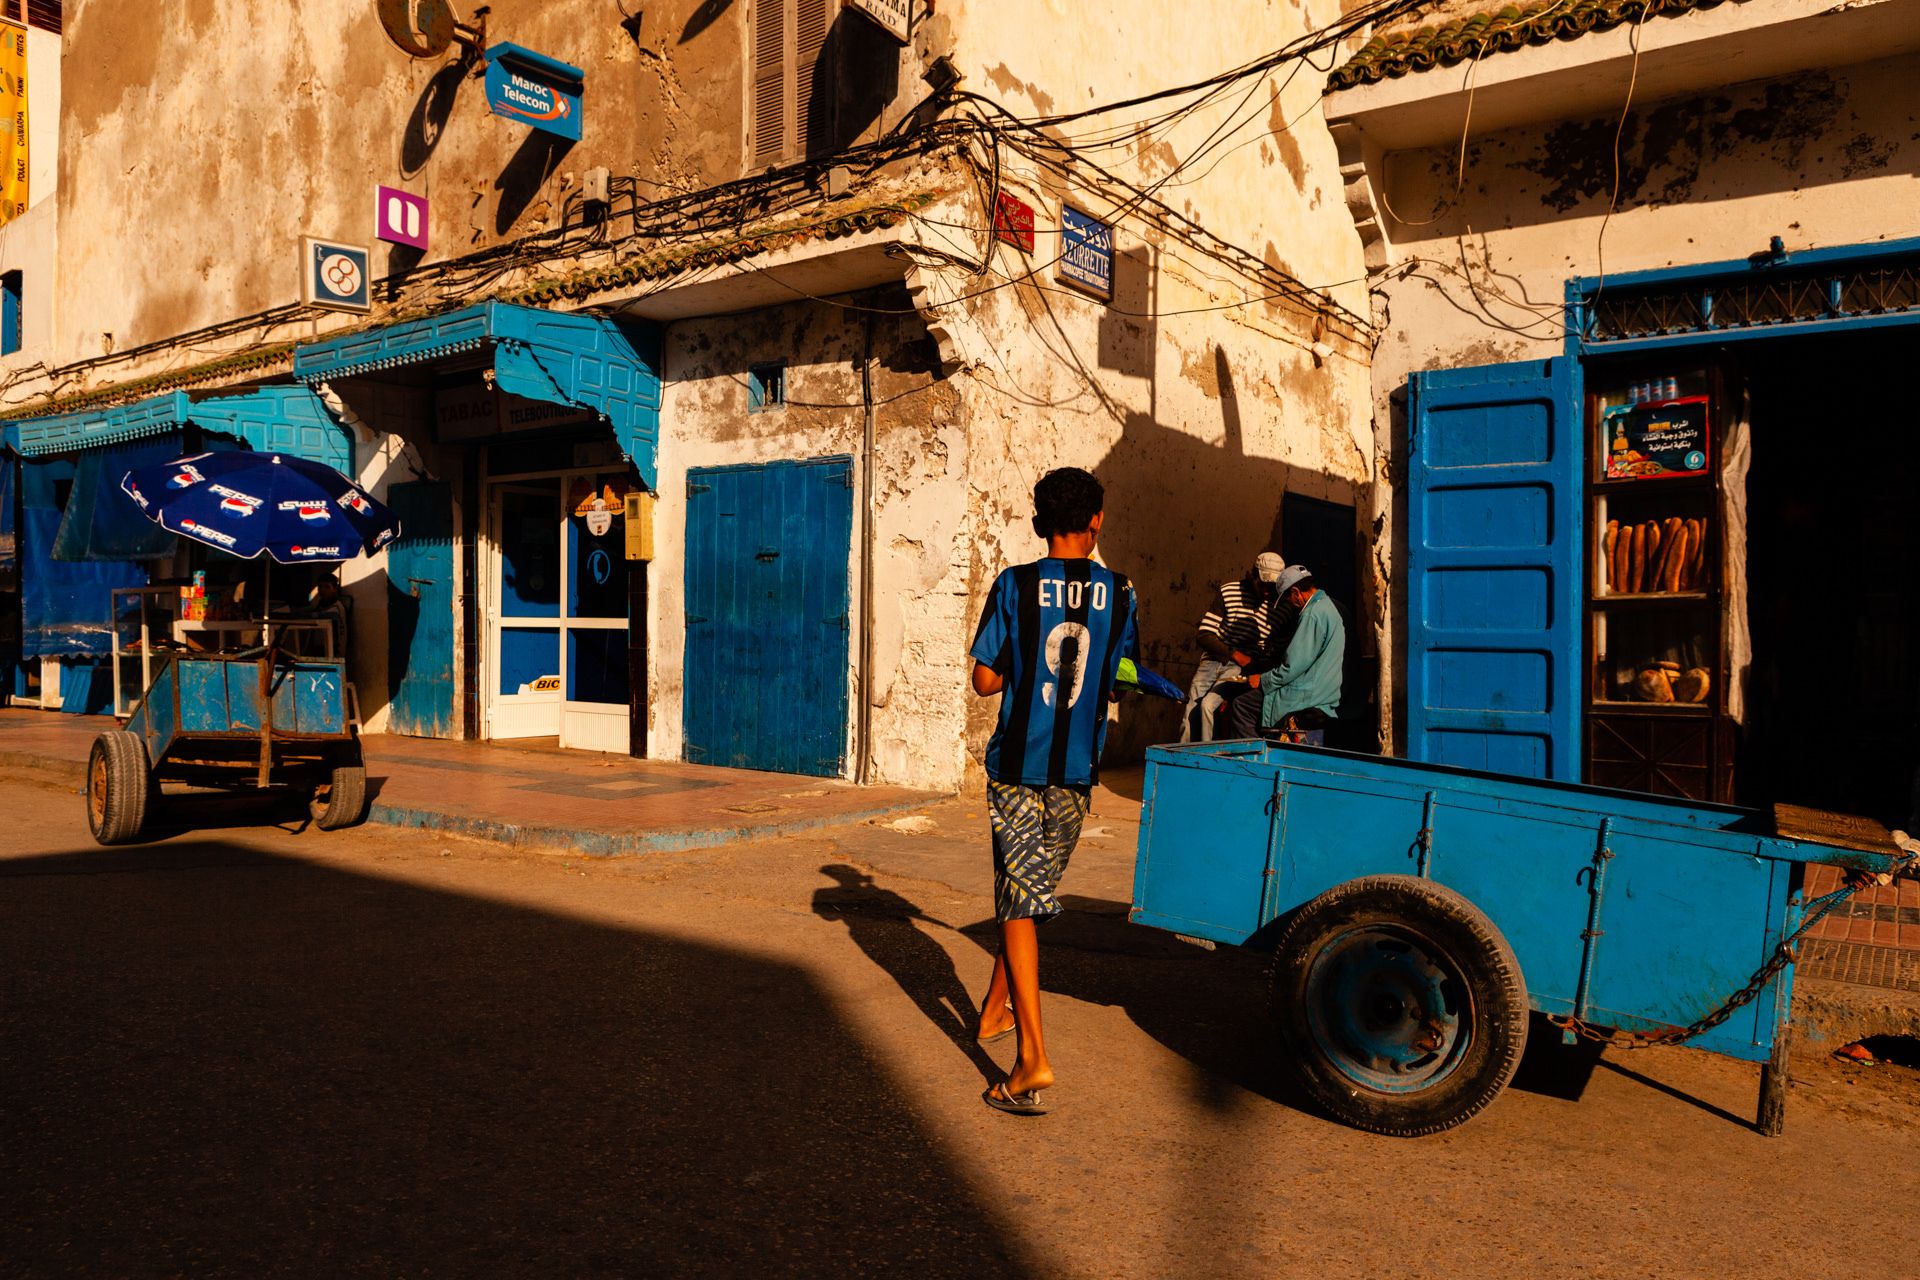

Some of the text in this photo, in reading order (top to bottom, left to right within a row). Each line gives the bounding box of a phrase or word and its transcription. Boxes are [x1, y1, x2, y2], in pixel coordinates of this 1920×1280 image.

[866, 0, 896, 26] RIAD
[16, 76, 24, 98] PANINI
[511, 73, 548, 97] Maroc
[502, 84, 550, 113] Telecom
[17, 158, 25, 183] POULET
[1061, 236, 1110, 277] AZURRETTE
[439, 400, 493, 423] TABAC
[1690, 453, 1699, 463] 6
[208, 484, 264, 509] PEPSI
[193, 524, 237, 547] PEPSI
[1041, 621, 1091, 710] 9
[536, 679, 560, 689] BIC
